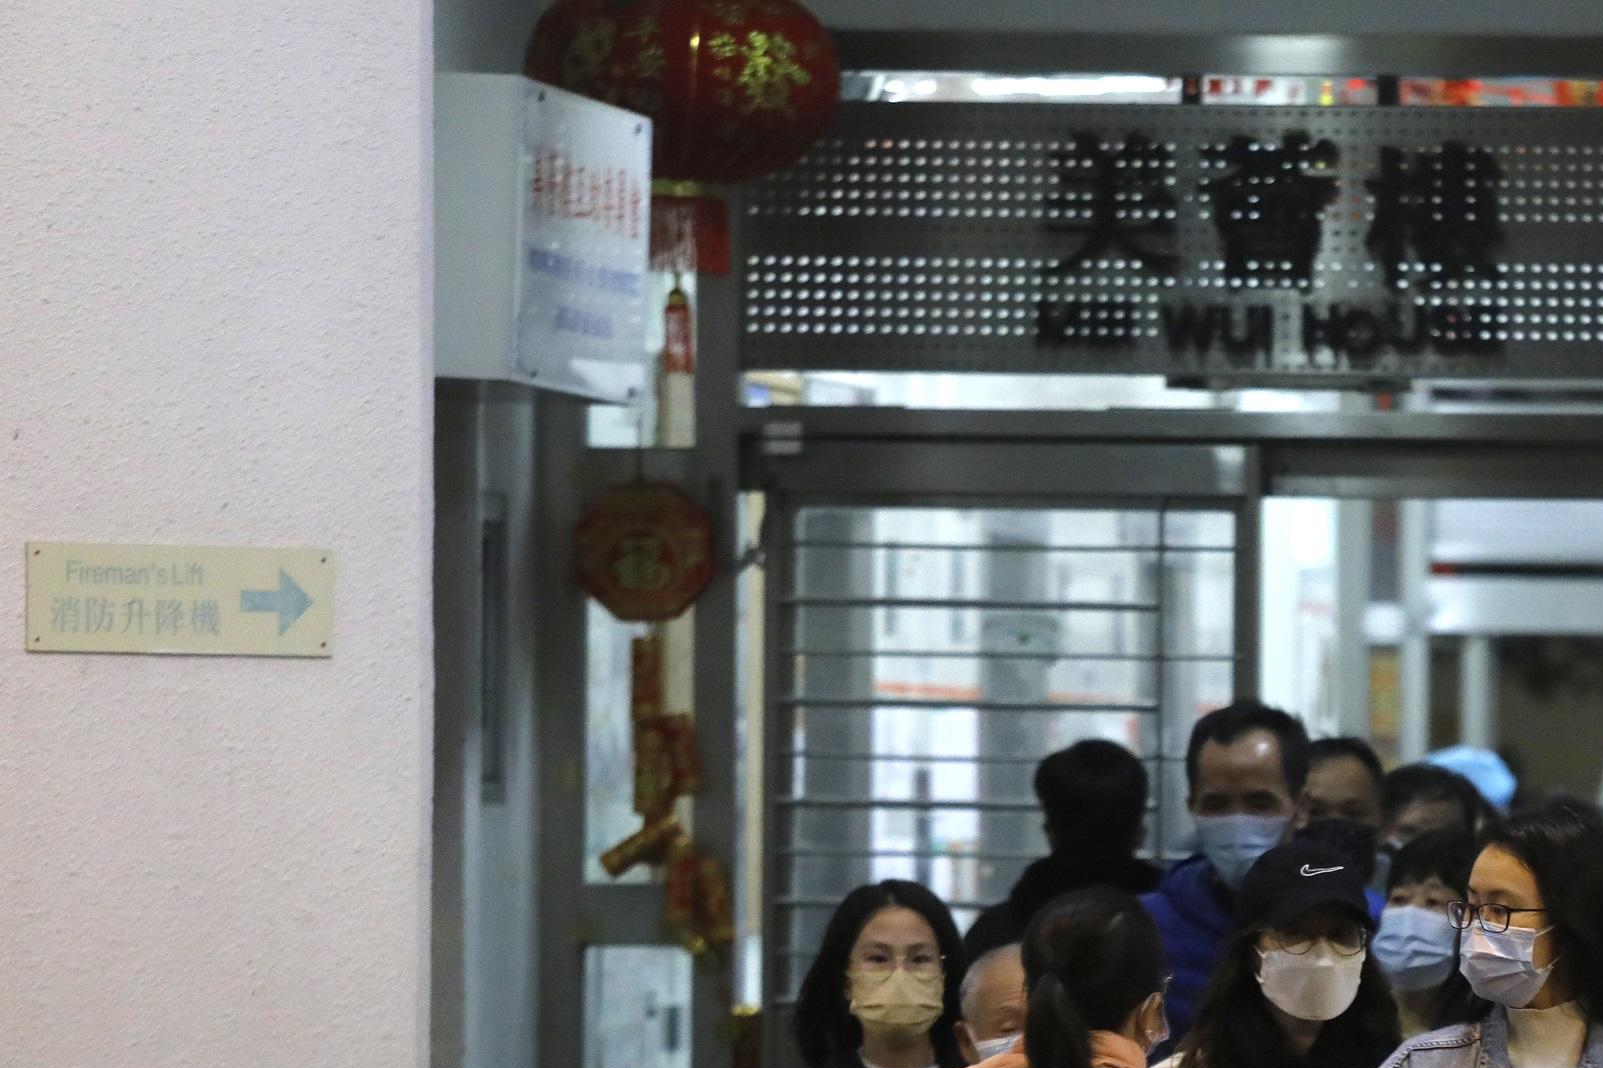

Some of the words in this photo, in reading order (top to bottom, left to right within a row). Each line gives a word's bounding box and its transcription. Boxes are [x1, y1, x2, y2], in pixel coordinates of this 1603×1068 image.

[65, 559, 169, 587] Fireman's
[172, 561, 204, 587] Lift
[50, 596, 221, 637] 消防升降機
